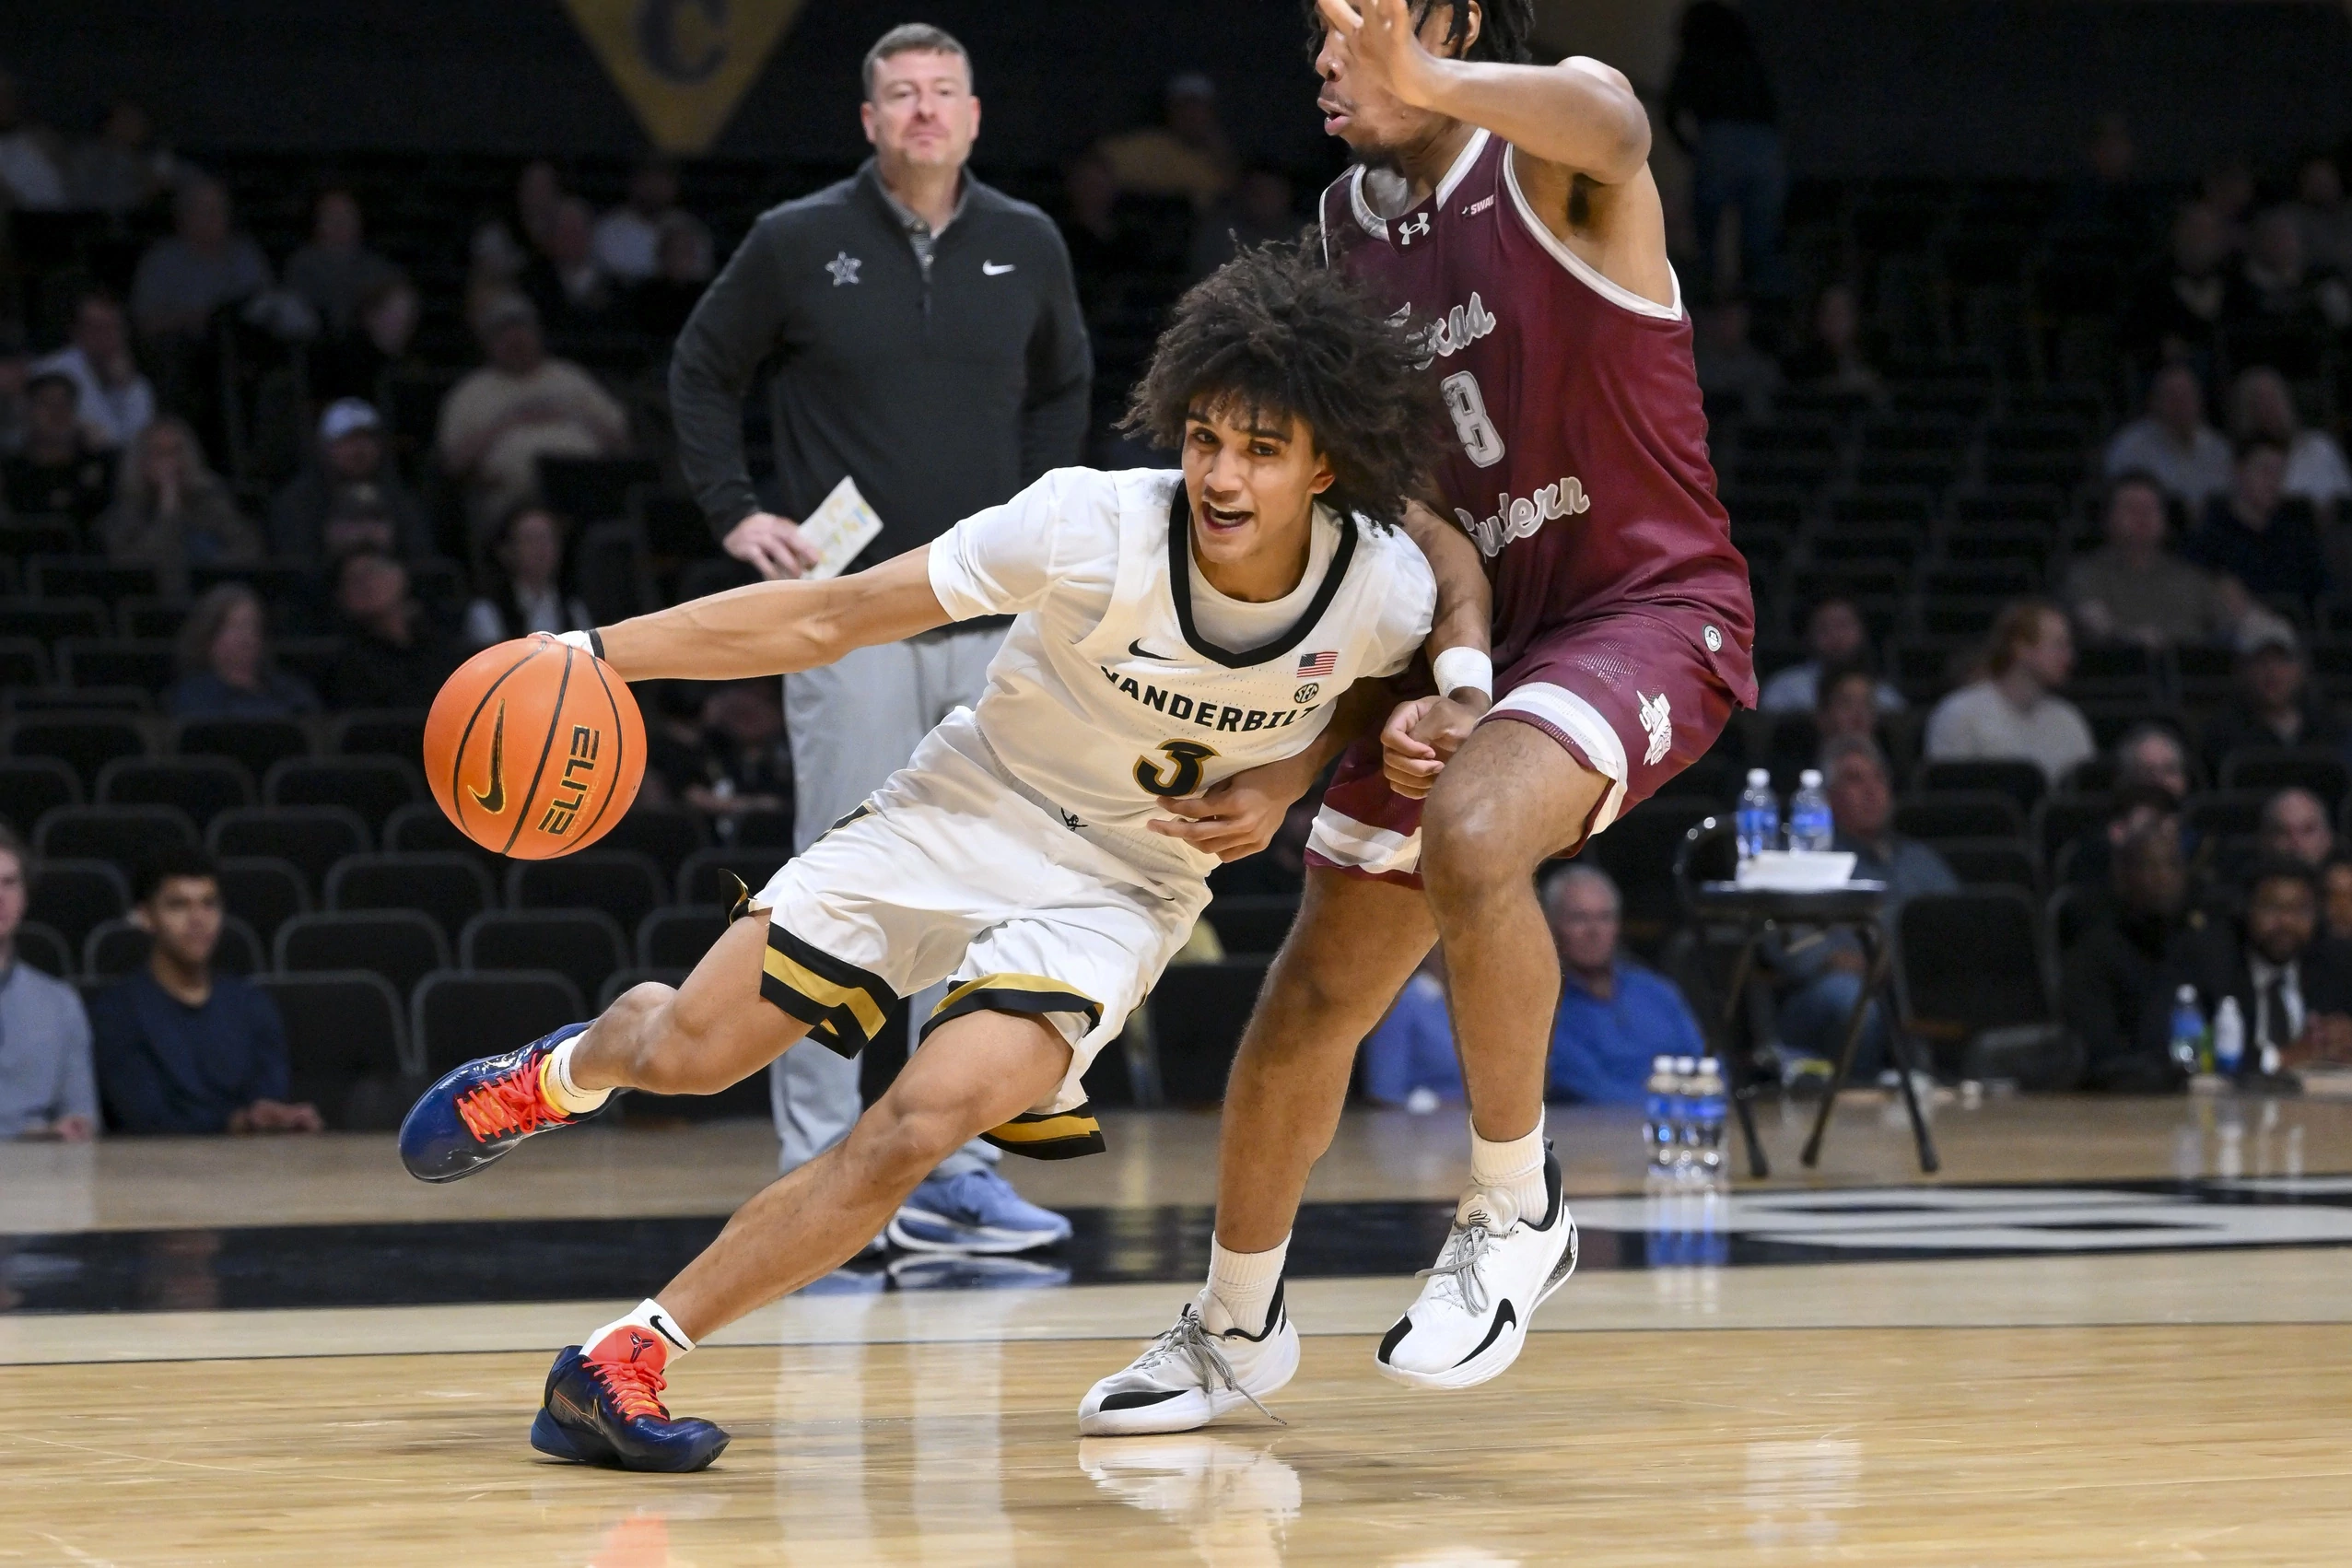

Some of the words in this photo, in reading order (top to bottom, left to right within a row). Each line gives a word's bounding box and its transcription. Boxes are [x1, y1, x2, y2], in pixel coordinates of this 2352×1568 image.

[1439, 370, 1505, 468] 8
[1100, 664, 1321, 733] VANDERBILT
[1294, 683, 1319, 704] SEC
[536, 724, 601, 836] ELITE
[1132, 737, 1223, 797] 3
